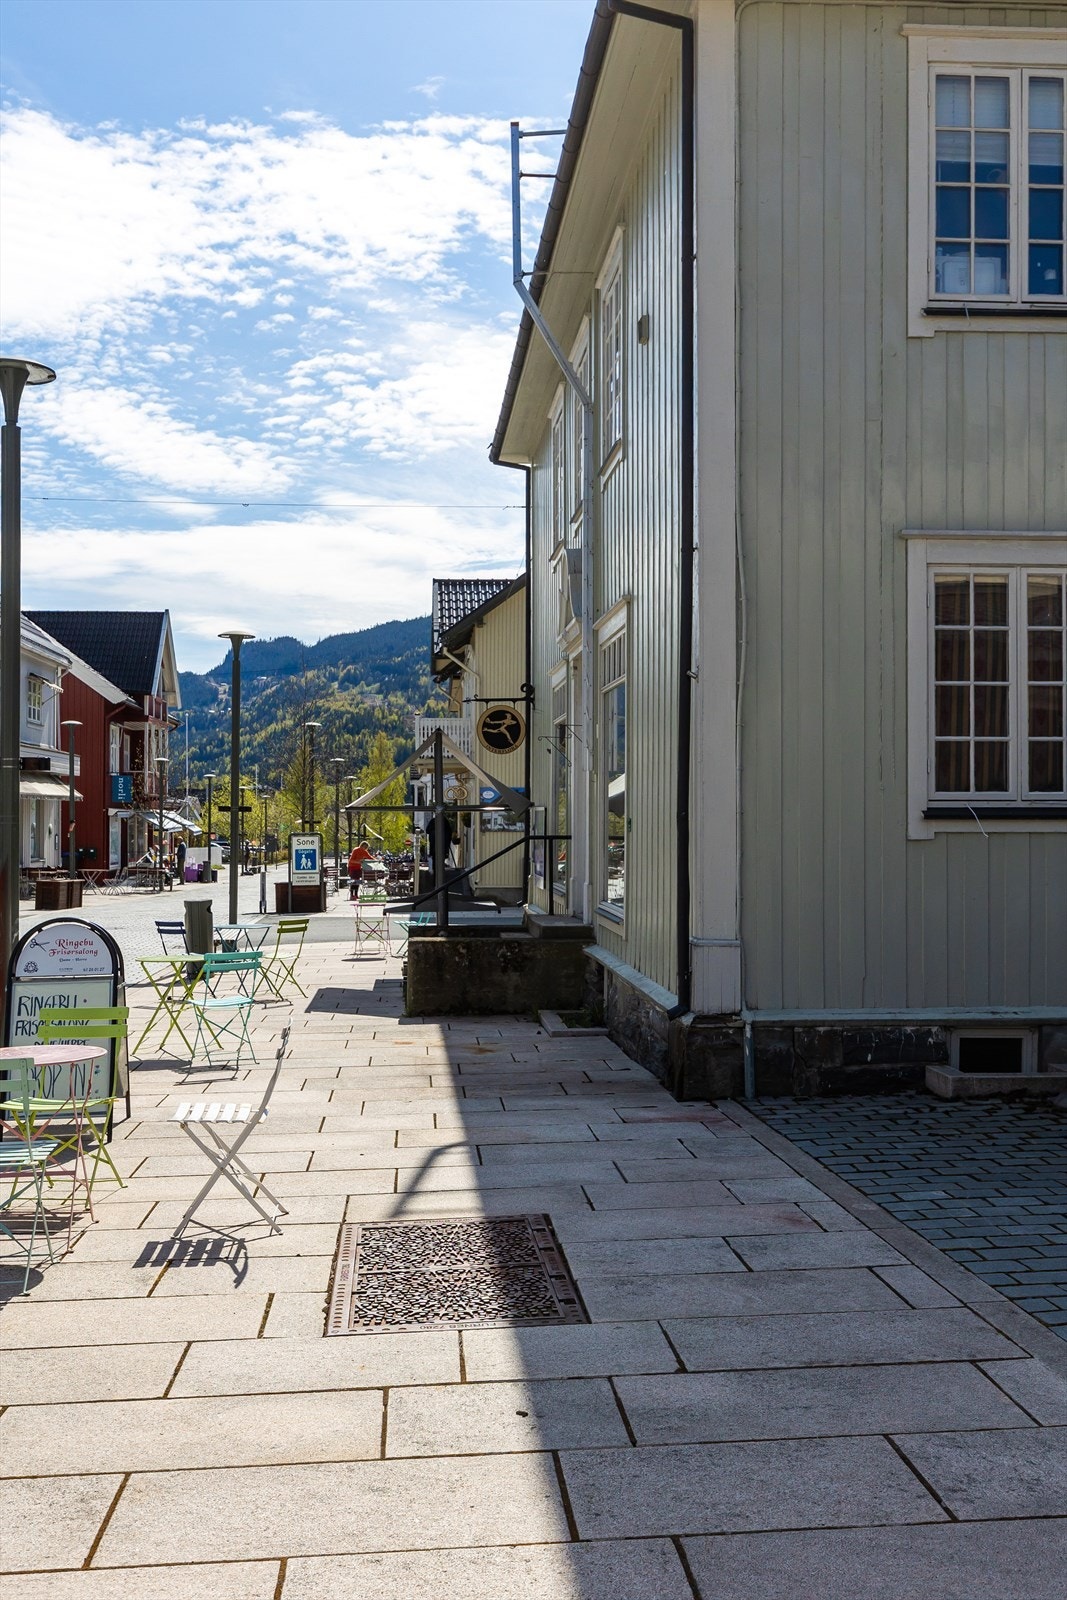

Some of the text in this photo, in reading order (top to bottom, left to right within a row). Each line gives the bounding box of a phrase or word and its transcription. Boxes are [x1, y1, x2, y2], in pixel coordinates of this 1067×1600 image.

[296, 838, 315, 846] Sone
[54, 938, 94, 949] Ringebu
[48, 948, 98, 957] Frisørsalong
